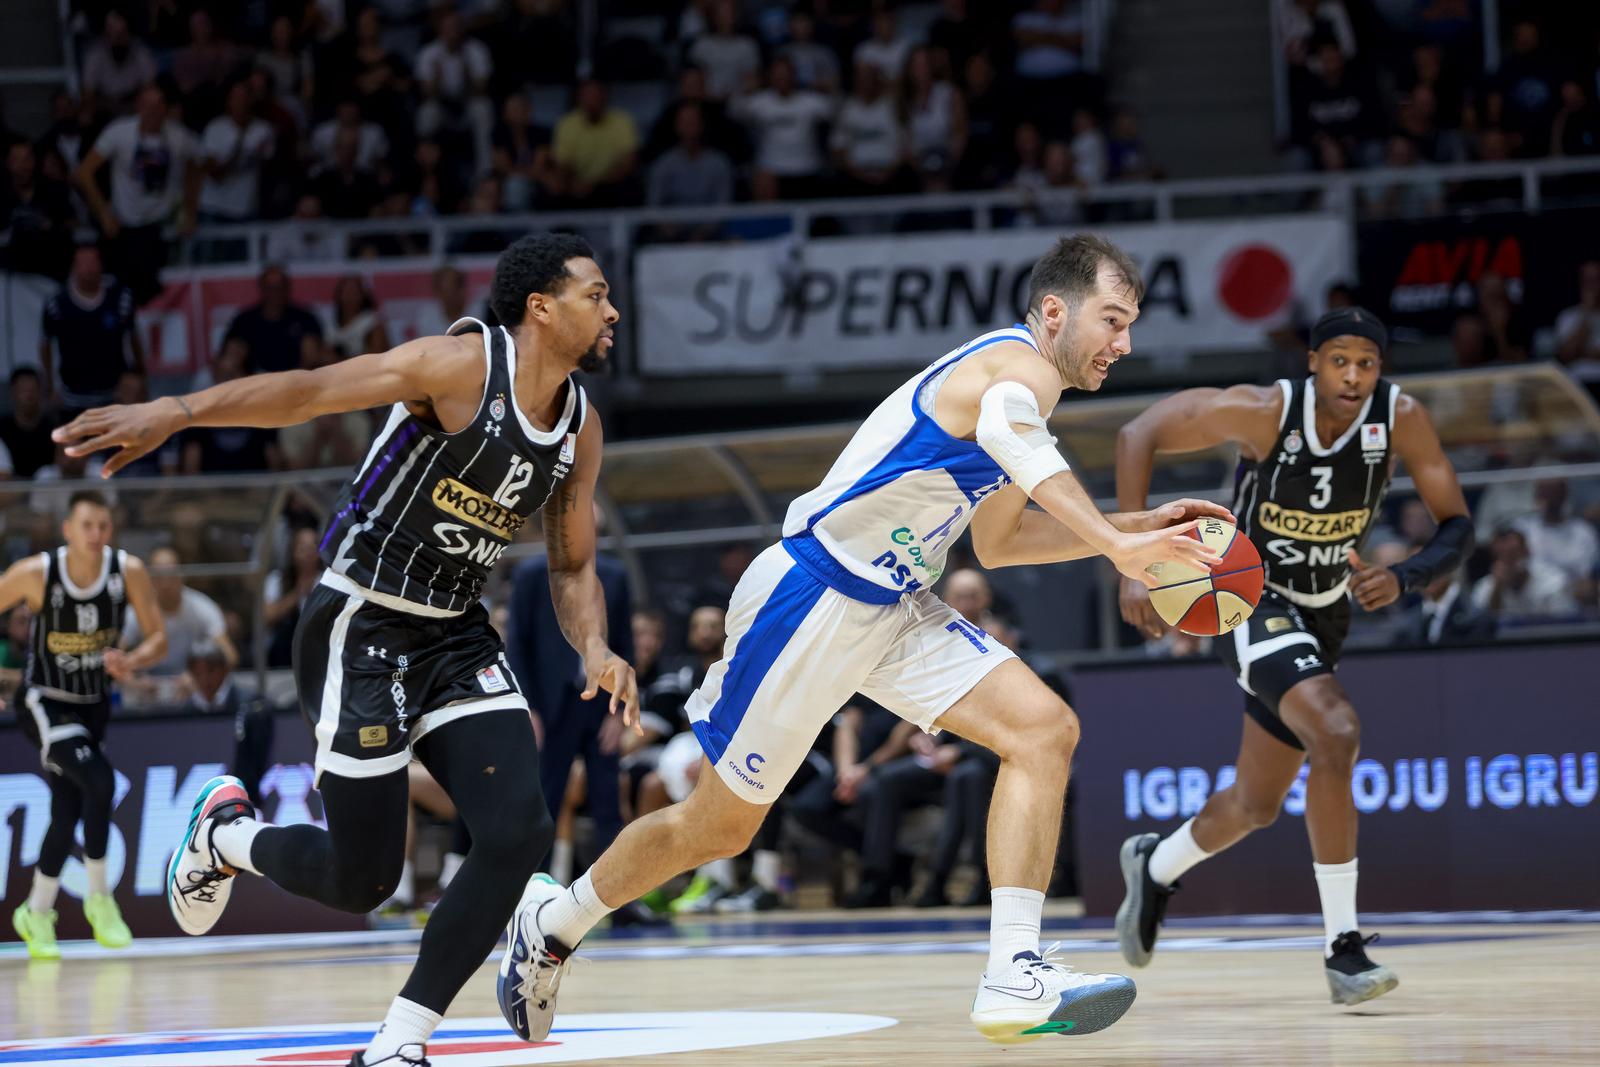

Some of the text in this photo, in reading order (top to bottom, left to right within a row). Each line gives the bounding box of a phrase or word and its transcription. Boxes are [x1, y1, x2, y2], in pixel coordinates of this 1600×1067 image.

[688, 250, 1192, 347] SUPERNA
[492, 454, 534, 510] 12
[1309, 466, 1333, 509] 3
[436, 484, 526, 535] MOZZA
[1263, 506, 1369, 537] MOZZART
[1308, 538, 1356, 567] NIS
[729, 760, 765, 790] cromaris
[1283, 757, 1449, 817] SOJU
[1465, 751, 1600, 809] IGRU
